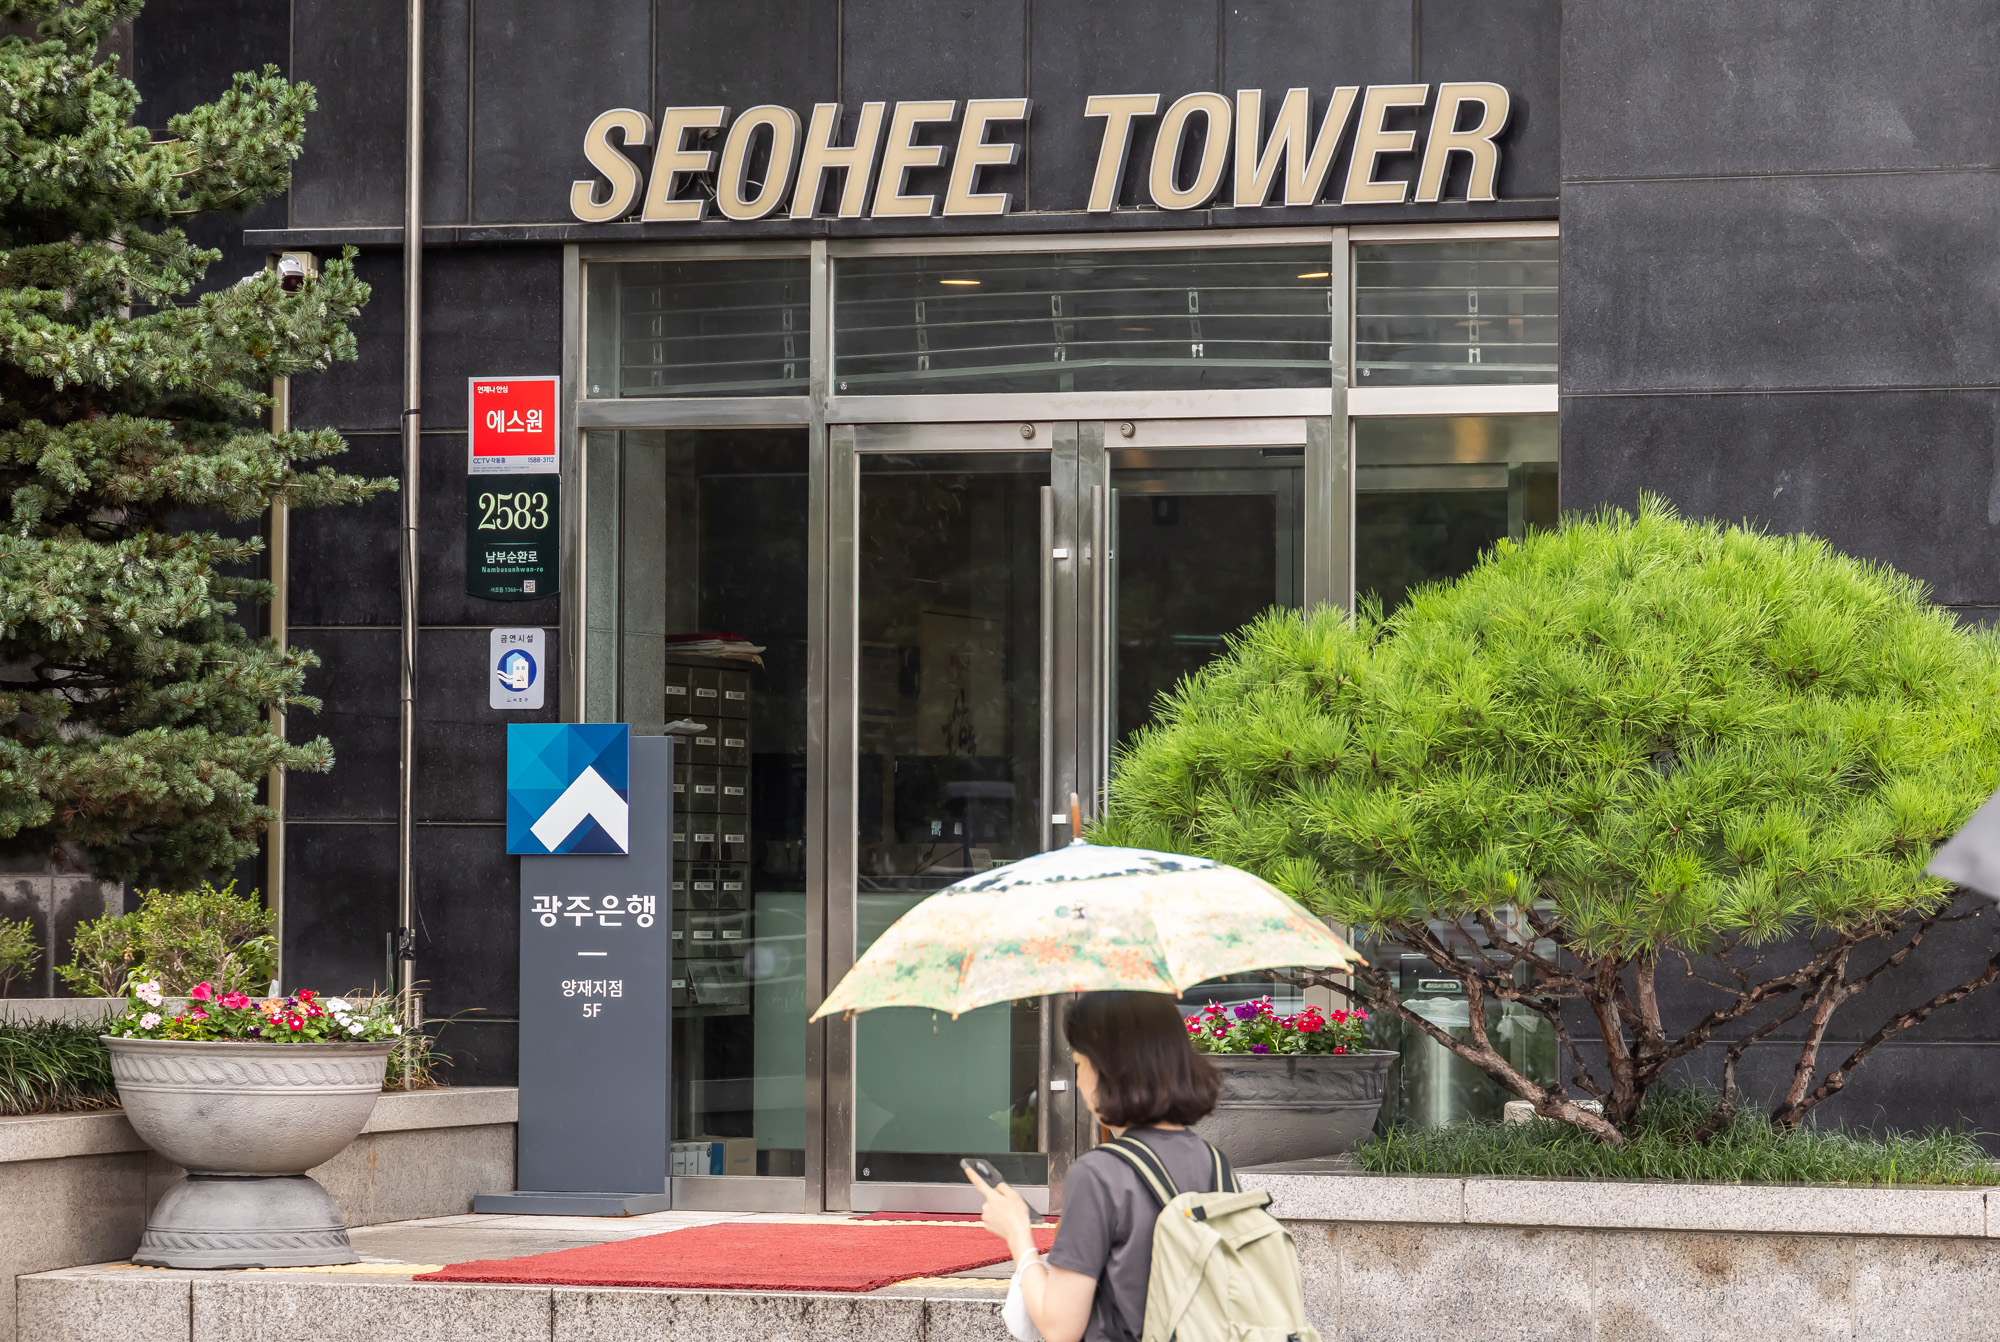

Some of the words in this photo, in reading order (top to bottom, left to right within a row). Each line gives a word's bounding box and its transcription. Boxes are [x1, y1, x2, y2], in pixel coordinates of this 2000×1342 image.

[569, 97, 1030, 224] SEOHEE
[1084, 81, 1512, 214] TOWER
[477, 385, 496, 394] 언제나
[496, 385, 509, 394] 안심
[486, 409, 543, 433] 에스원
[478, 492, 549, 530] 2583
[485, 551, 538, 564] 남부순환로
[500, 634, 534, 644] 금연시설
[531, 894, 656, 928] 광주은행
[561, 979, 623, 998] 양재지점
[582, 1003, 602, 1018] 5F
